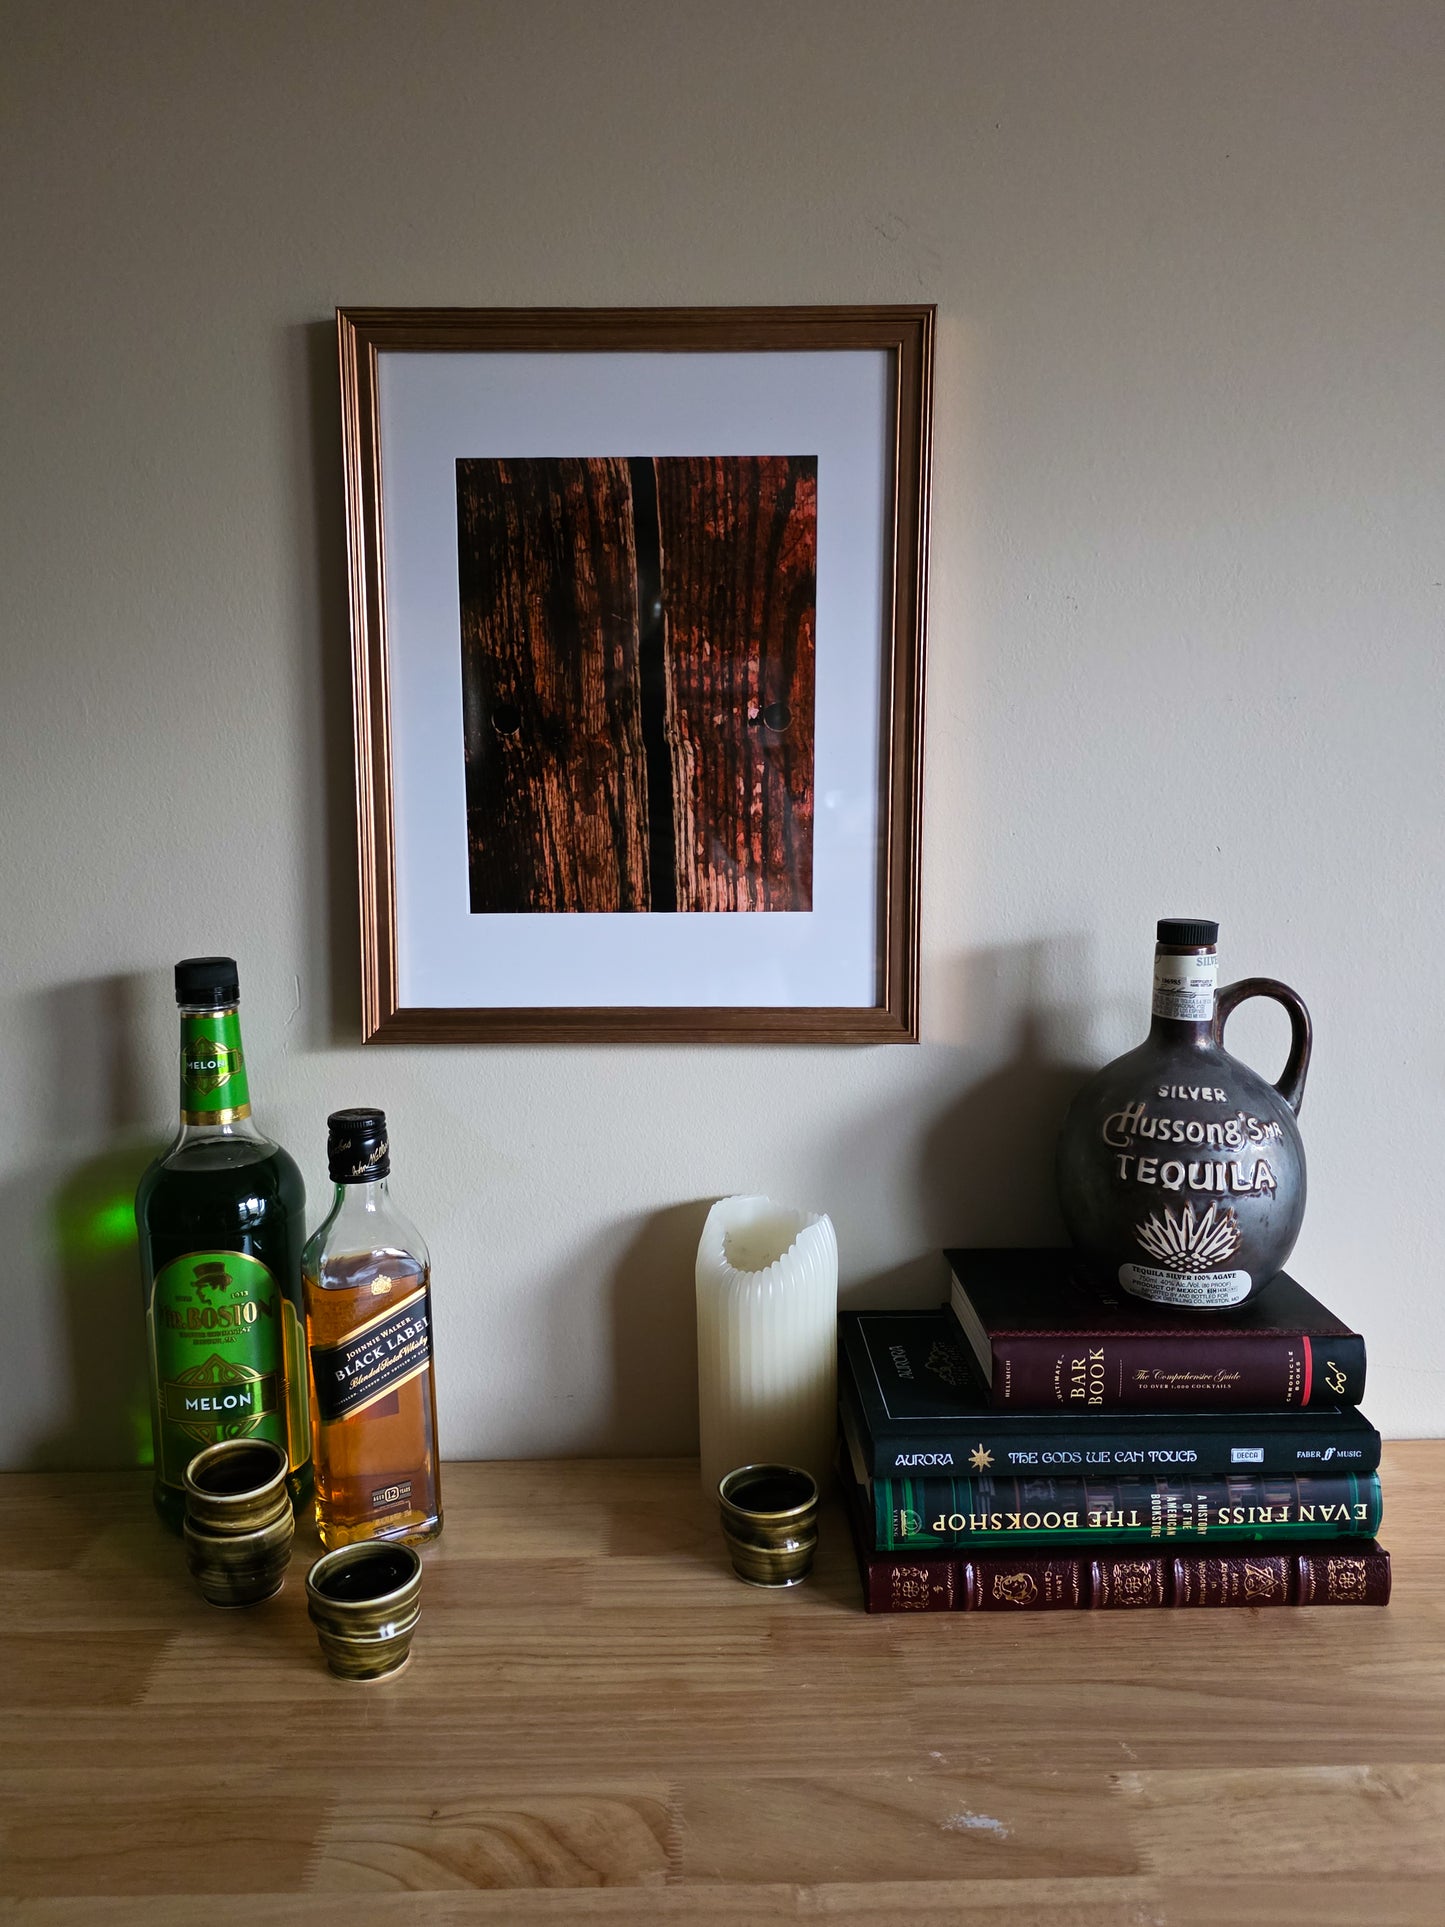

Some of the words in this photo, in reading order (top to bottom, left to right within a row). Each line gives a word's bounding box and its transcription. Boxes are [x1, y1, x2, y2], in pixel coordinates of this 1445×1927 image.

[187, 1060, 226, 1070] MELON
[1158, 1085, 1228, 1103] SILVER
[1116, 1153, 1278, 1192] TEQUILA
[1132, 1266, 1164, 1278] TEQUILA
[1166, 1273, 1192, 1281] SILVER
[1213, 1272, 1237, 1280] AGAVE
[1132, 1279, 1164, 1291] PRODUCT
[186, 1296, 274, 1330] BOSTON
[334, 1345, 385, 1381] BLACK
[386, 1316, 430, 1351] LABEL
[346, 1337, 381, 1361] JOHNNIE
[349, 1366, 381, 1391] Blended
[402, 1335, 428, 1356] Whisky
[1054, 1359, 1063, 1401] ULTIMATE
[1070, 1358, 1086, 1398] BAR
[1088, 1348, 1104, 1405] BOOK
[1132, 1369, 1150, 1382] The
[1152, 1368, 1214, 1385] Comprehensive
[1214, 1368, 1241, 1382] Guide
[1286, 1350, 1294, 1402] CHRONICLE
[185, 1392, 252, 1411] MELON
[895, 1453, 954, 1467] AURORA
[1008, 1452, 1038, 1464] THE
[1041, 1451, 1082, 1464] GODS
[1085, 1451, 1111, 1464] WE
[1114, 1451, 1144, 1463] CAN
[1148, 1450, 1198, 1462] TOUCH
[1236, 1452, 1259, 1460] DECCA
[1336, 1450, 1362, 1458] MUSIC
[387, 1489, 397, 1500] 12
[1150, 1494, 1162, 1538] BOOKSTORE
[1166, 1496, 1177, 1536] AMERICAN
[1182, 1503, 1192, 1514] OF
[1218, 1506, 1289, 1525] FRISS
[1298, 1503, 1368, 1521] EVAN
[932, 1511, 1079, 1532] BOOKSHOP
[1088, 1510, 1142, 1528] THE
[1182, 1515, 1192, 1530] THE
[1197, 1504, 1208, 1536] HISTORY
[1044, 1570, 1053, 1602] Carroll
[1055, 1574, 1064, 1599] Lewis
